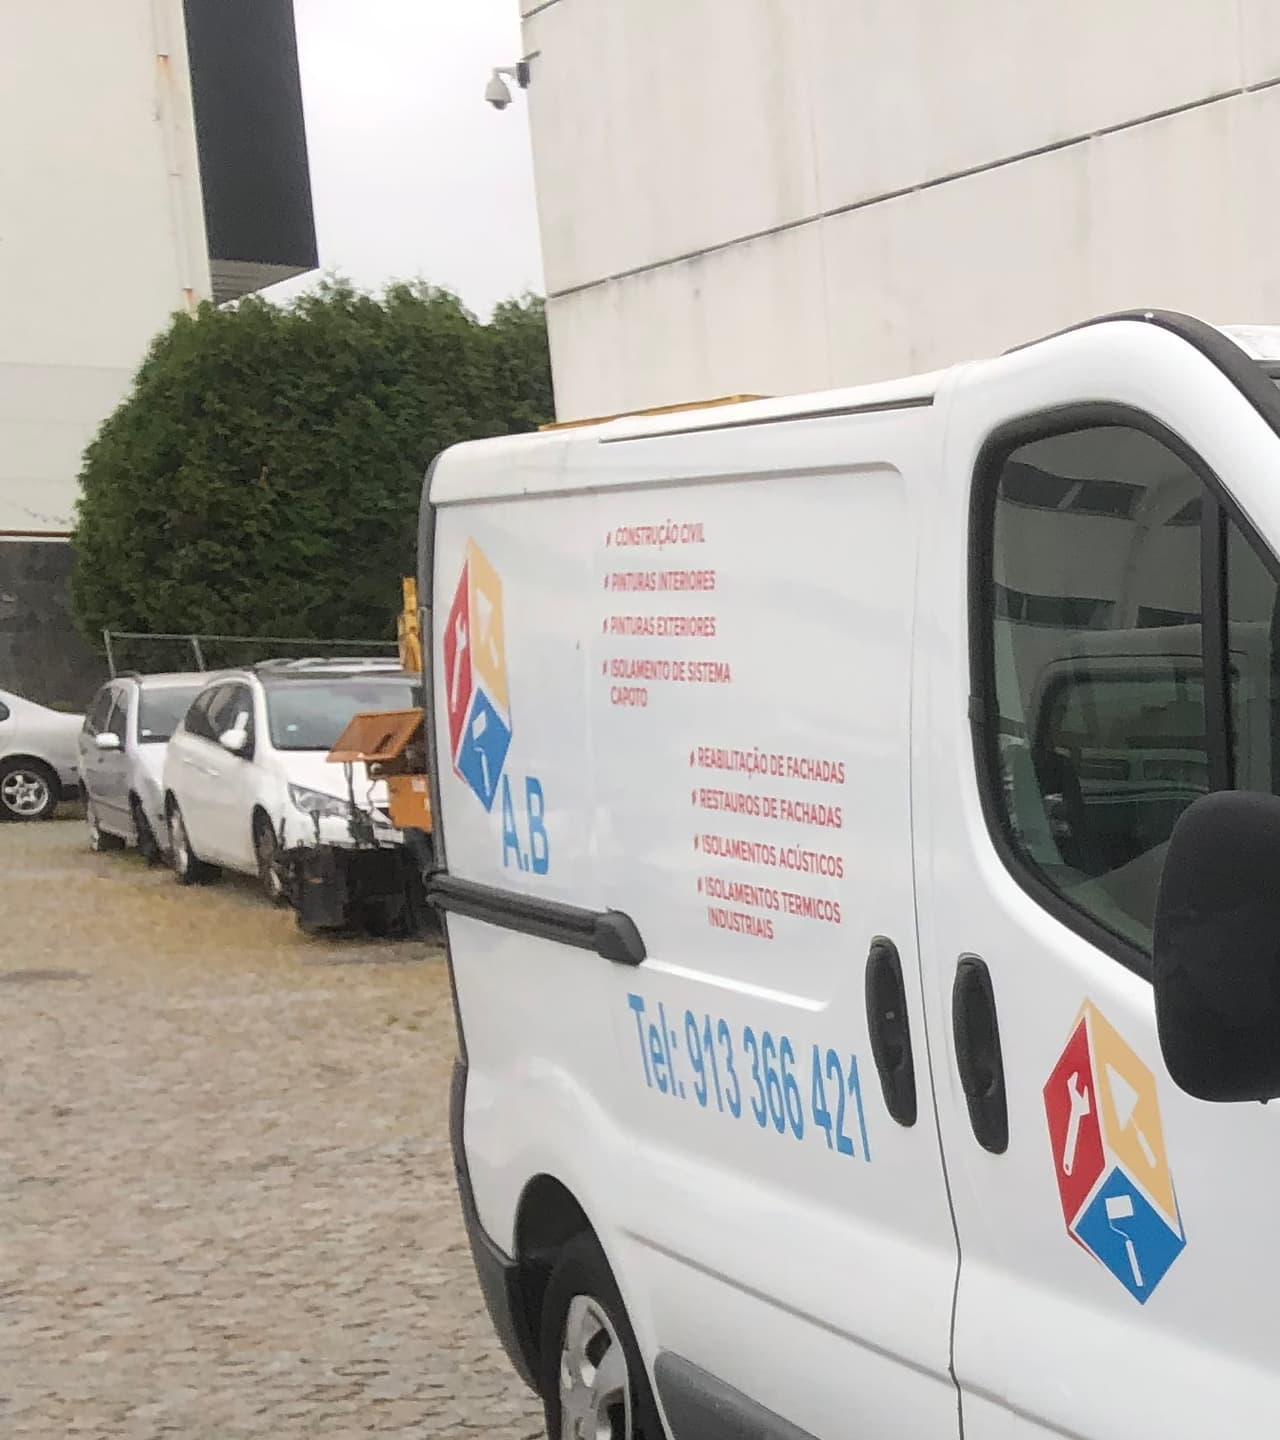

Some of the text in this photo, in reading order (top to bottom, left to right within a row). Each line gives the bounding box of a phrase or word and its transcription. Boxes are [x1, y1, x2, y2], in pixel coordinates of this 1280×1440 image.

[615, 518, 705, 551] CONSTRUÇÃO CIVIL
[611, 570, 715, 592] PINTURAS INTERIORES
[610, 615, 715, 637] PINTURAS EXTERIORES
[610, 658, 731, 683] ISOLAMENTO DE SISTEMA
[610, 686, 648, 707] CAPOTO
[698, 746, 845, 784] REABILITAÇÃO DE FACHADAS
[502, 774, 549, 875] A.B
[700, 788, 842, 828] RESTAUROS DE FACHADAS
[702, 834, 844, 878] ISOLAMENTOS ACÚSTICOS
[704, 876, 841, 924] ISOLAMENTOS TERMICOS
[708, 906, 774, 940] INDUSTRIAIS
[628, 992, 870, 1162] Tel: 913 366 421
